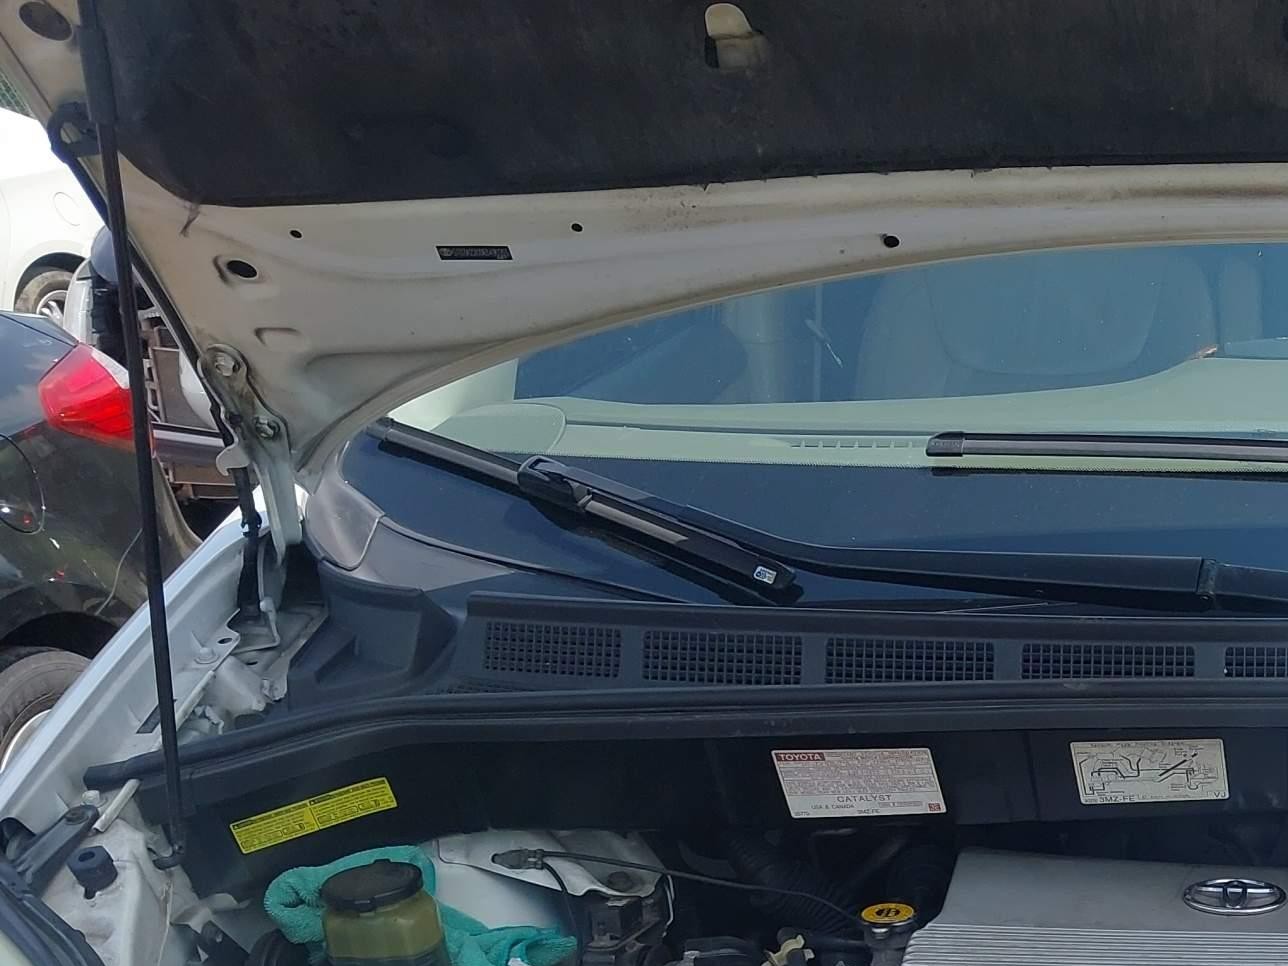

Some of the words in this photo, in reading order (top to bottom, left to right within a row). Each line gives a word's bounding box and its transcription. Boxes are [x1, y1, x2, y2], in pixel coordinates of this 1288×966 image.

[778, 753, 824, 762] TOYOTA
[836, 794, 892, 803] CATALYST
[1099, 795, 1136, 803] 3MZ-FE
